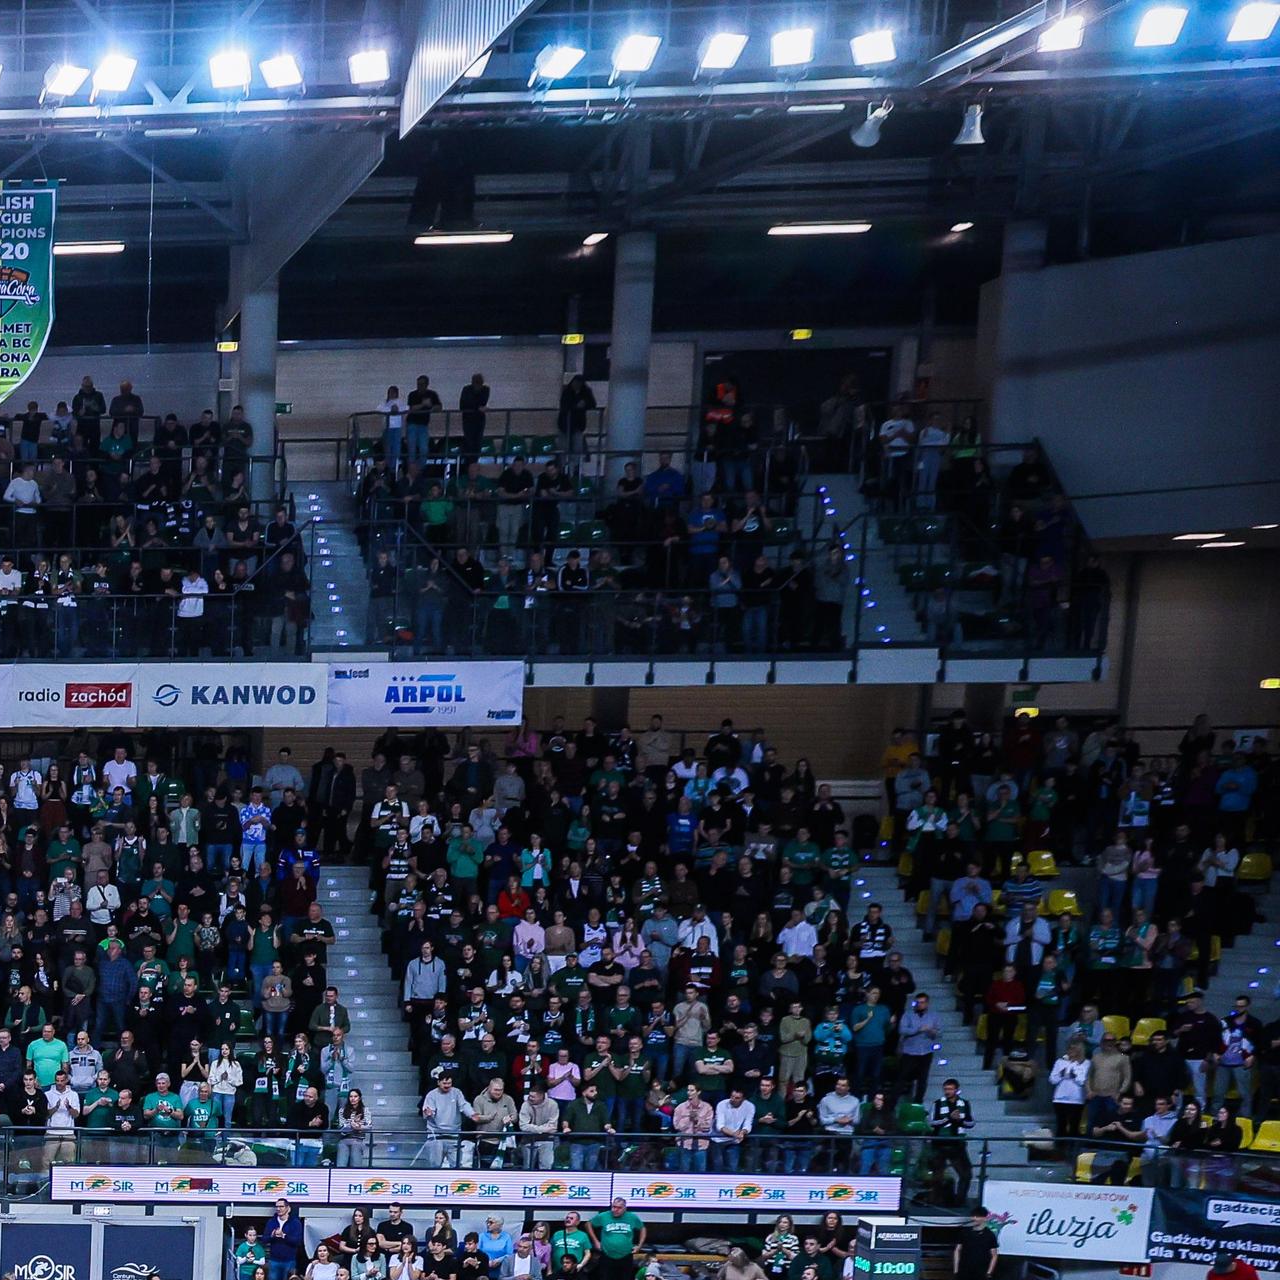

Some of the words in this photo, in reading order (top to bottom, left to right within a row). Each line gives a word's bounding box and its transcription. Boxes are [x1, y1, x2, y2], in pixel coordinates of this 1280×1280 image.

[12, 338, 32, 348] BC
[19, 687, 61, 703] radio
[70, 687, 127, 703] zachód
[191, 685, 317, 705] KANWOD
[384, 684, 466, 704] ARPOL
[1025, 1208, 1119, 1248] iluzja
[1150, 1230, 1216, 1250] Gadżety
[1148, 1246, 1174, 1259] dla
[873, 1262, 915, 1274] 10:00
